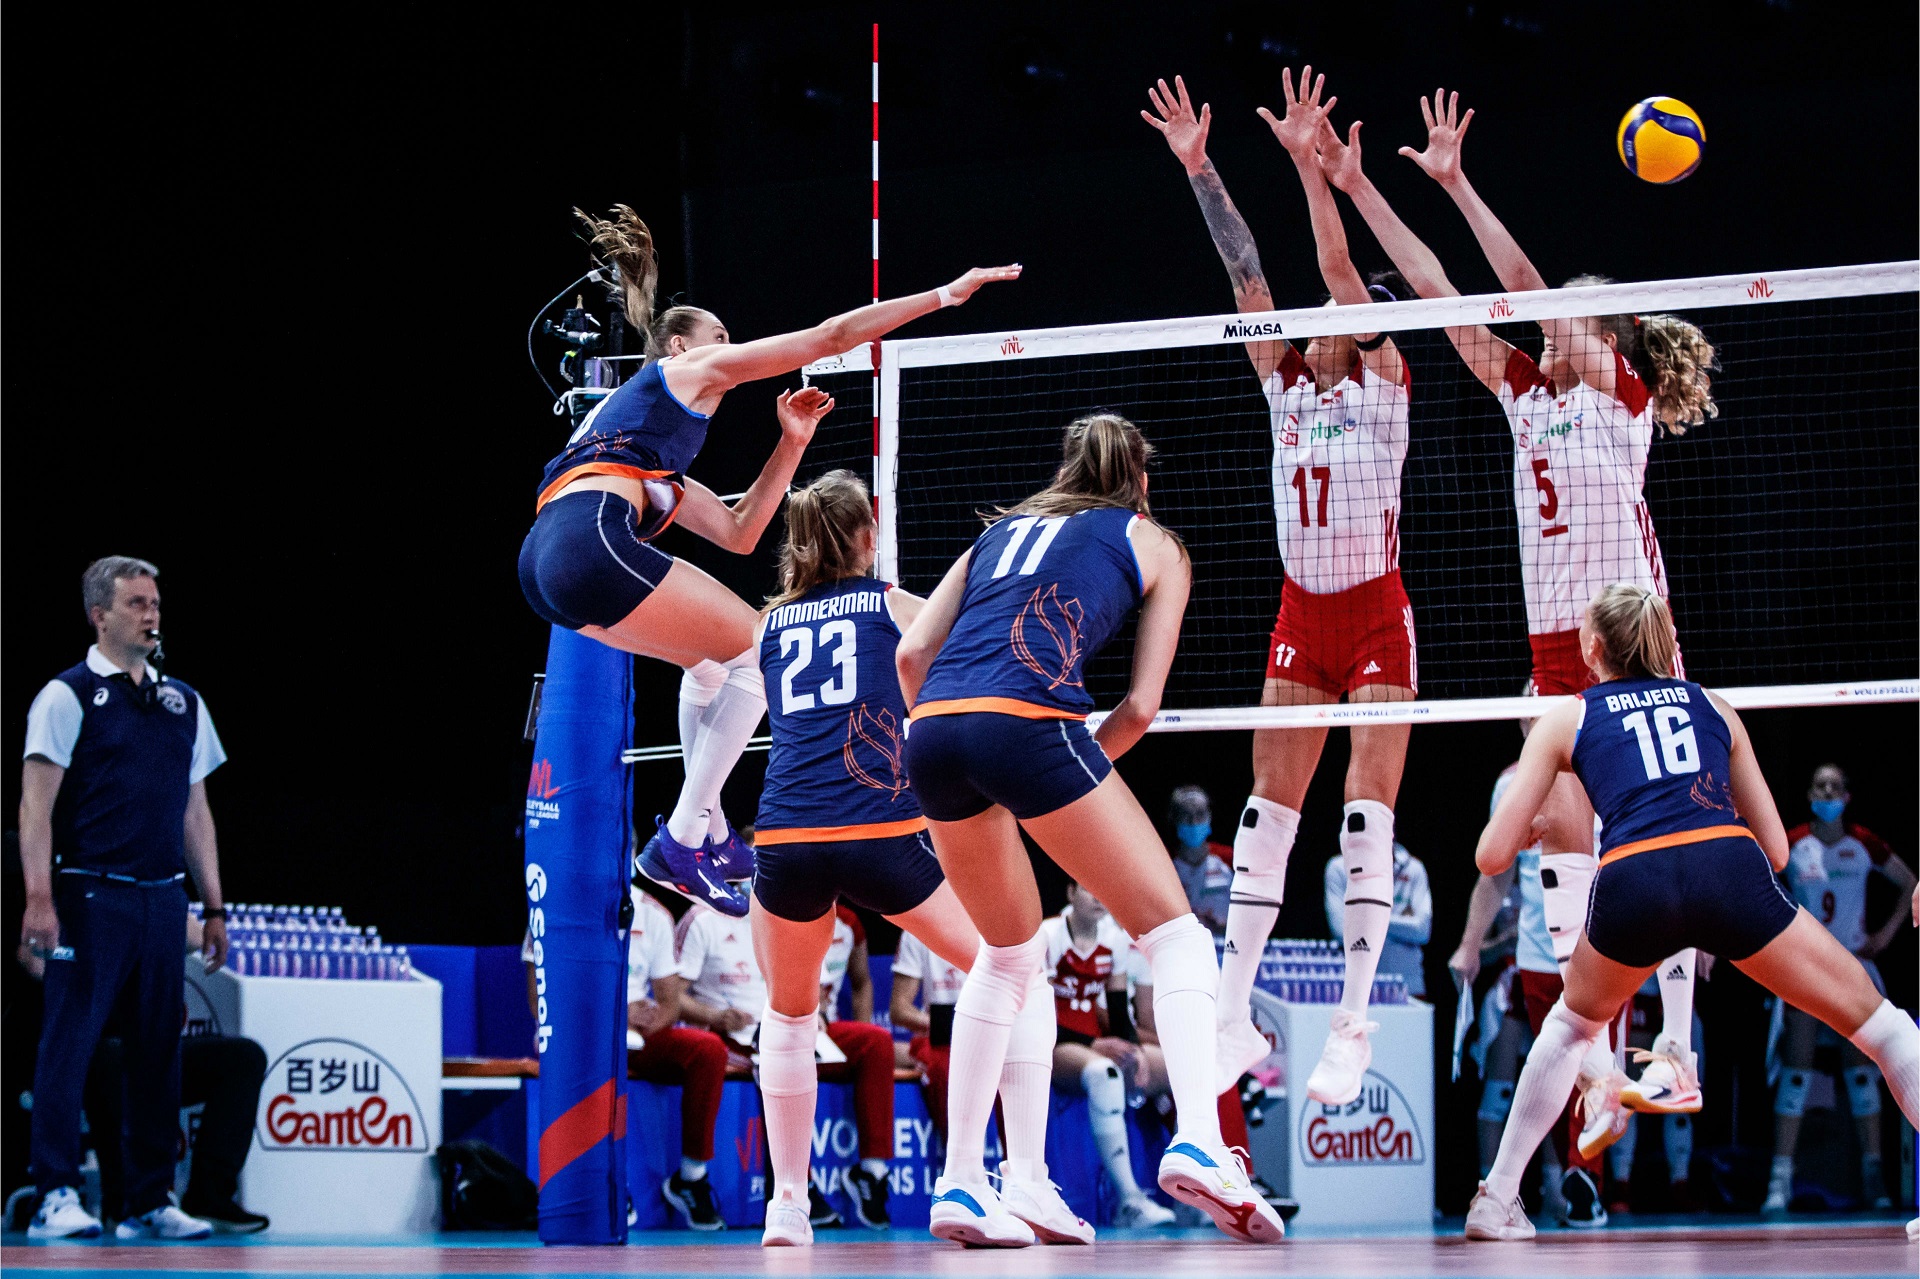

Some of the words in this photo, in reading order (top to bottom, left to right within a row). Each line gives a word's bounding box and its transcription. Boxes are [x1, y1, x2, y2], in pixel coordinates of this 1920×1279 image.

[1222, 319, 1283, 339] MIKASA
[1291, 466, 1331, 528] 17
[1531, 458, 1559, 521] 5
[991, 516, 1071, 580] 11
[770, 591, 882, 631] TIMMERMAN
[779, 619, 858, 716] 23
[1276, 643, 1296, 668] 17
[1605, 686, 1691, 713] BAIJENS
[1621, 705, 1701, 781] 16
[1821, 890, 1835, 923] 9
[529, 907, 553, 1054] Senoh
[285, 1057, 380, 1095] 百岁山
